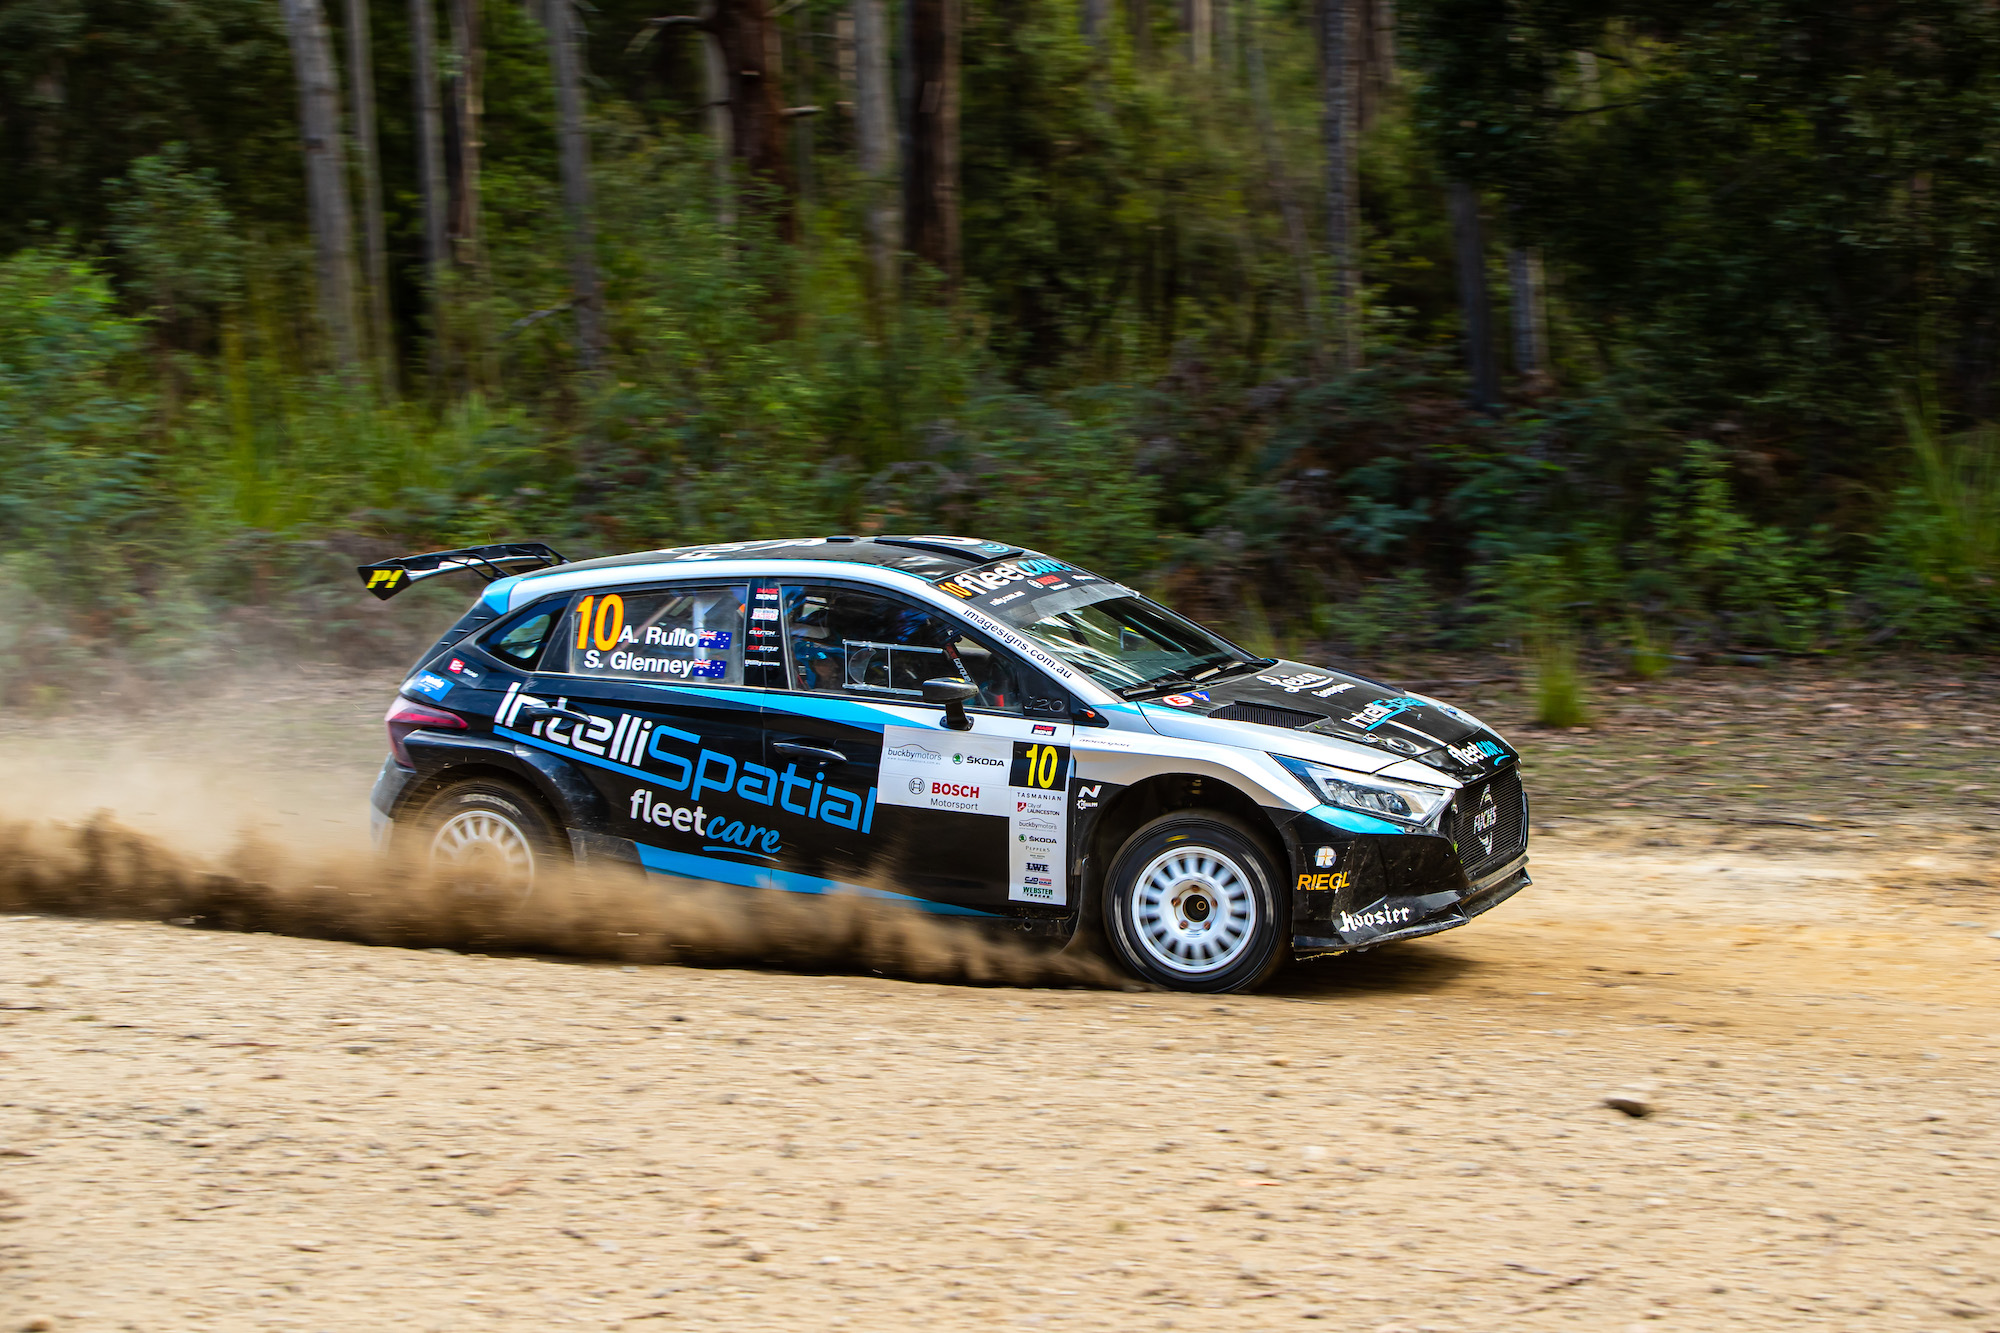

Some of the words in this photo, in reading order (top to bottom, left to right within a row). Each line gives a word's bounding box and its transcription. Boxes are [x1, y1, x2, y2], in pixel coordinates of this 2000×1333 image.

[938, 582, 972, 598] 10
[576, 593, 625, 651] 10
[616, 625, 640, 644] A.
[645, 626, 698, 648] Rullo
[963, 608, 1073, 680] imagesigns.com.au
[584, 649, 604, 669] S.
[609, 651, 695, 679] Glenney
[494, 681, 877, 834] IntelliSpatial
[887, 747, 942, 761] buckbymotors
[966, 755, 1005, 767] ŠKODA
[1447, 740, 1504, 767] fleetcare
[1026, 743, 1059, 789] 10
[931, 782, 980, 799] BOSCH
[1017, 792, 1062, 801] TASMANIAN
[930, 798, 979, 811] Motorsport
[1027, 808, 1060, 816] LAUNCESTON
[629, 788, 782, 854] fleetcare
[1028, 835, 1058, 845] ŠKODA
[1022, 886, 1053, 896] WEBSTER
[1297, 871, 1351, 891] RIEGL
[1340, 903, 1410, 933] Hoosier
